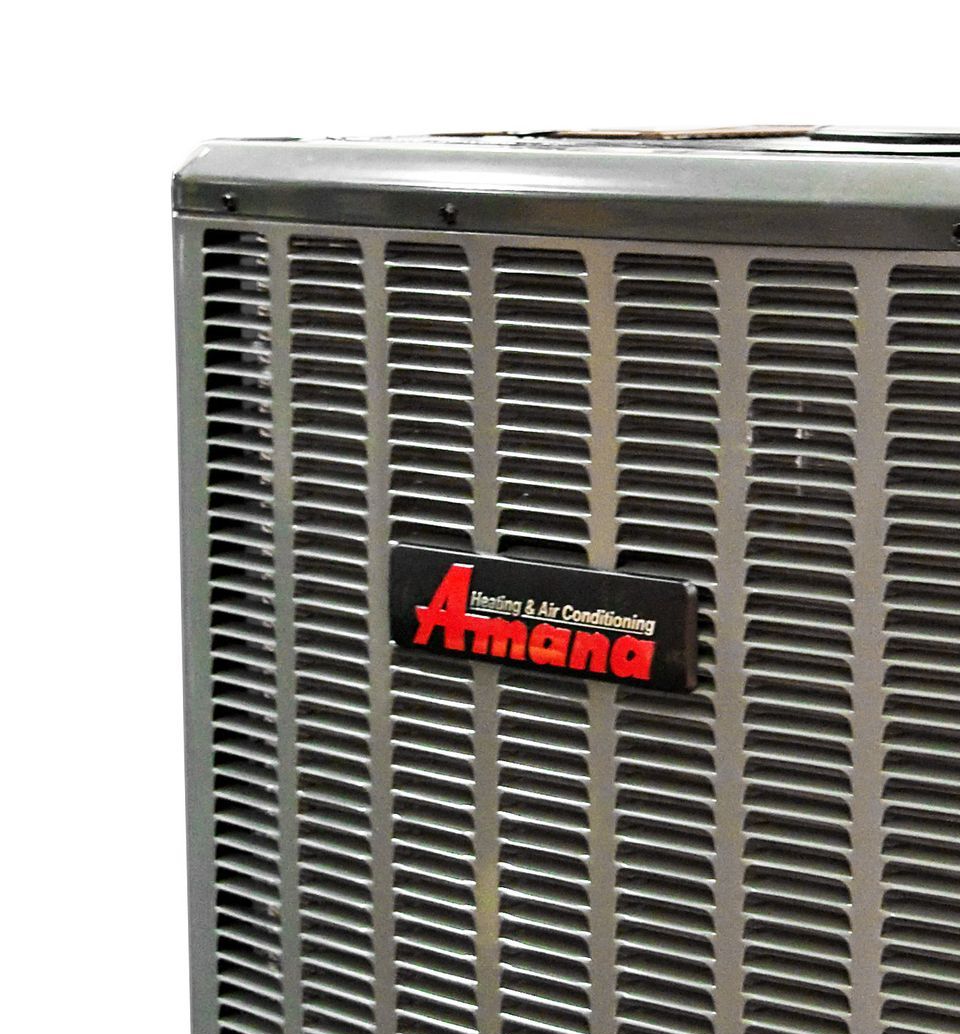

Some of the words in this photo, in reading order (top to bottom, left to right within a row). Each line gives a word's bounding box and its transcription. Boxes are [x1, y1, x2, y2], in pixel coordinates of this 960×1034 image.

[413, 563, 656, 680] Amana
[470, 590, 522, 616] Heating
[525, 598, 536, 615] &
[537, 601, 559, 618] Air
[562, 605, 656, 636] Conditioning
